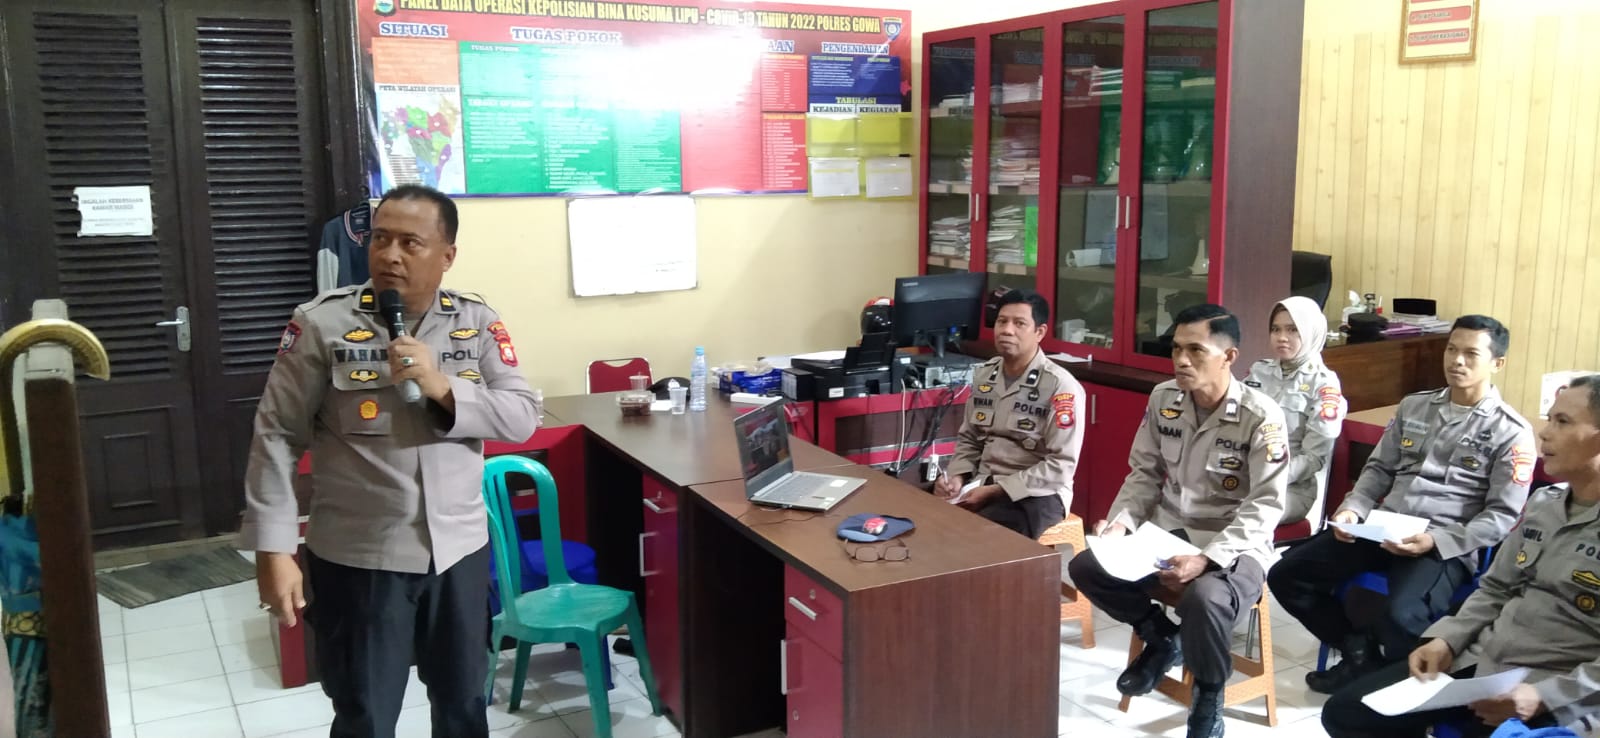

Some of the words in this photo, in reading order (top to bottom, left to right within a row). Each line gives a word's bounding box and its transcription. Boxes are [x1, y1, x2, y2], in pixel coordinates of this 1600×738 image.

[441, 0, 472, 11] DATA
[475, 0, 526, 14] OPERASI
[529, 0, 595, 18] KEPOLISIAN
[597, 2, 625, 20] BINA
[626, 4, 674, 22] KUSUMA
[675, 6, 699, 24] LIPU
[756, 11, 789, 29] TAHUN
[790, 13, 816, 30] 2022
[817, 15, 851, 32] POLRES
[852, 16, 881, 33] GOWA
[380, 23, 447, 36] SITUASI
[511, 28, 563, 41] TUGAS
[567, 31, 620, 43] POKOK
[822, 43, 889, 54] PENGENDALIAN
[836, 96, 877, 104] TABULASI
[813, 105, 852, 113] KEJADIAN
[859, 105, 898, 113] KEGIATAN
